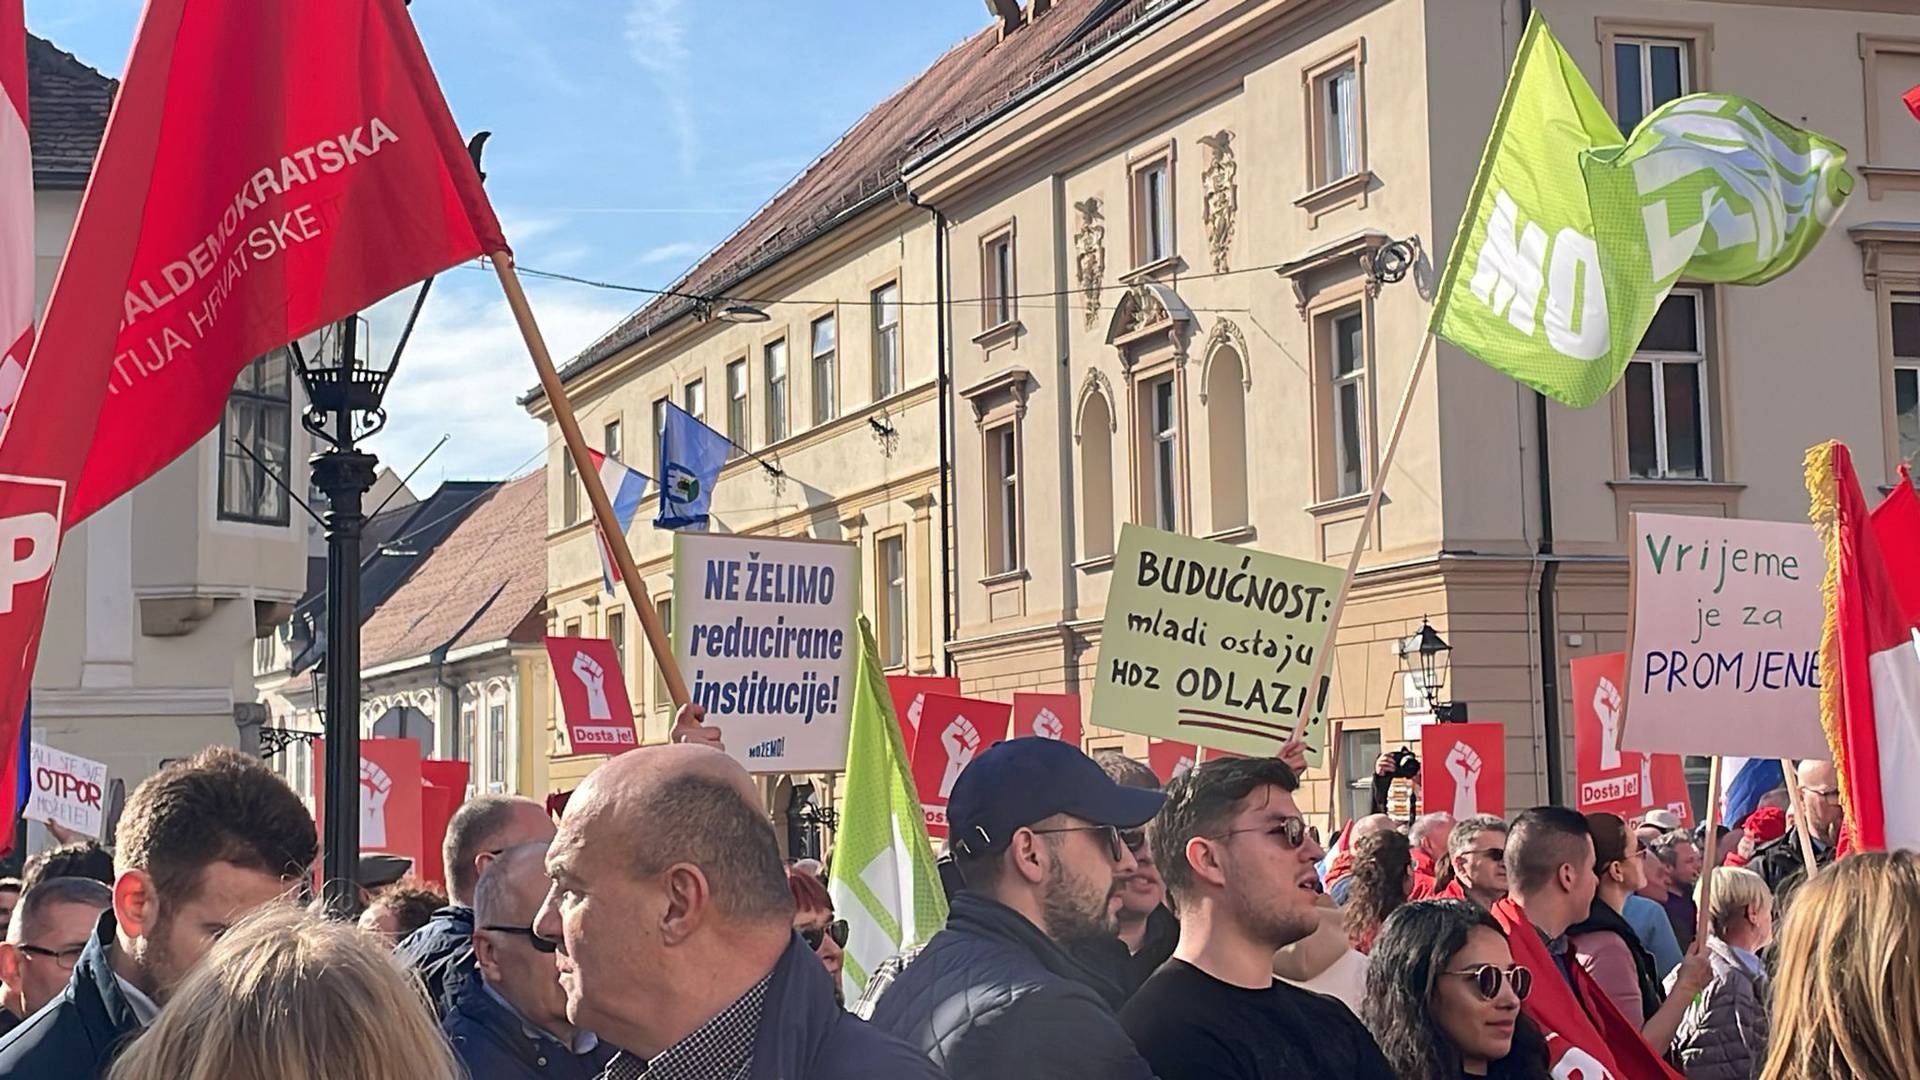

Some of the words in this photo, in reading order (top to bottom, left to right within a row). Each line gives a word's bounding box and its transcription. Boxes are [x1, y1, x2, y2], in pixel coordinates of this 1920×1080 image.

[120, 117, 399, 332] ALDEMOKRATSKA
[108, 327, 192, 394] TIJA
[187, 203, 321, 338] HRVATSKE
[704, 560, 741, 600] NE
[745, 551, 835, 605] ŽELIMO
[1137, 551, 1331, 623] BUDUĆNOST:
[1646, 533, 1800, 594] Vrijeme
[690, 616, 843, 660] reducirane
[1128, 608, 1208, 646] mladi
[1220, 629, 1313, 673] ostaju
[1690, 598, 1721, 644] je
[1742, 606, 1783, 629] za
[692, 670, 840, 724] institucije!
[1112, 658, 1160, 690] HDZ
[1644, 650, 1822, 694] PROMJENE
[576, 729, 614, 742] Dosta
[616, 729, 632, 744] je!
[37, 767, 102, 811] OTPOR
[1584, 783, 1620, 802] Dosta
[1623, 777, 1637, 797] je!
